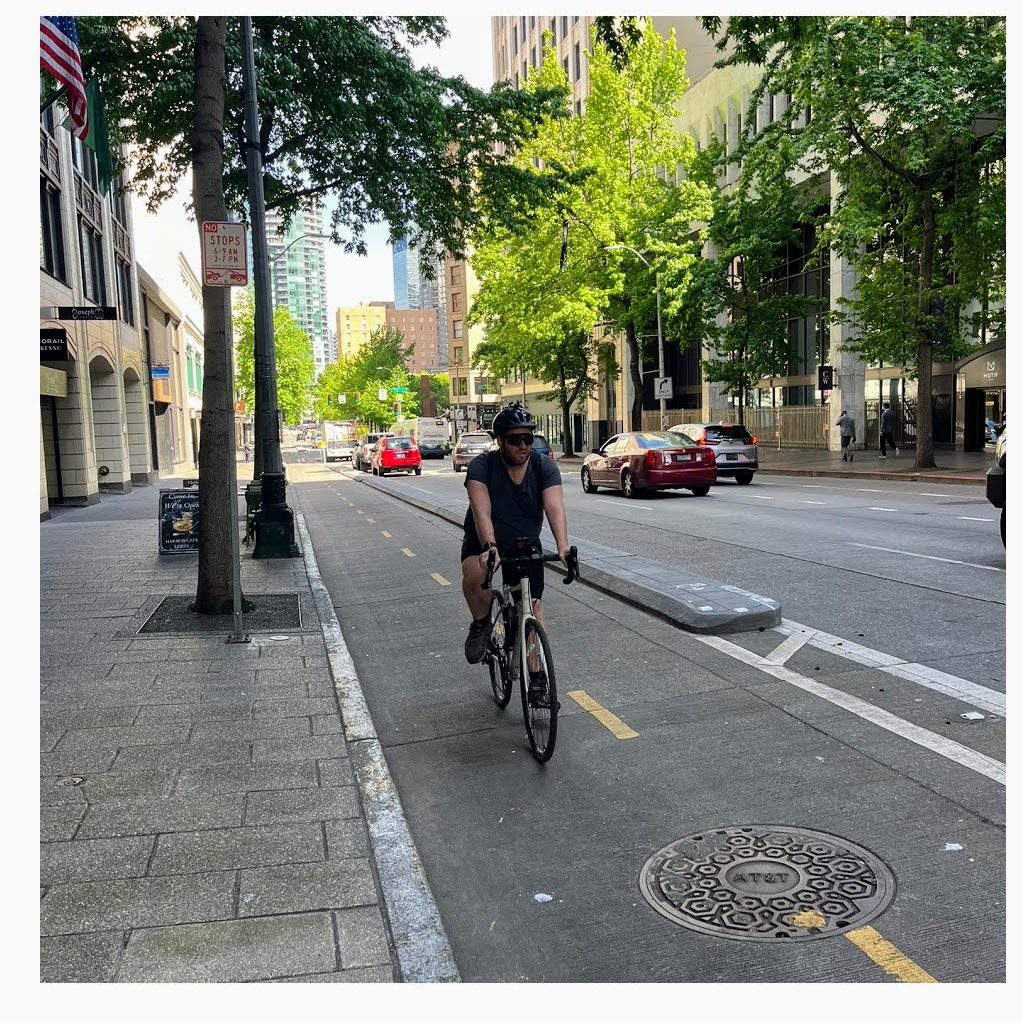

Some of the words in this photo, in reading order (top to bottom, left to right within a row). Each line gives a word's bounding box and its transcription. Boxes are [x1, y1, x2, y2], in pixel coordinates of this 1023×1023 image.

[205, 223, 217, 232] NO
[210, 235, 241, 247] STOPS
[213, 247, 227, 255] 6-9
[228, 247, 238, 255] AM
[213, 255, 226, 263] 3-7
[228, 255, 239, 263] PM
[164, 502, 183, 510] We're
[732, 872, 790, 884] AT&T
